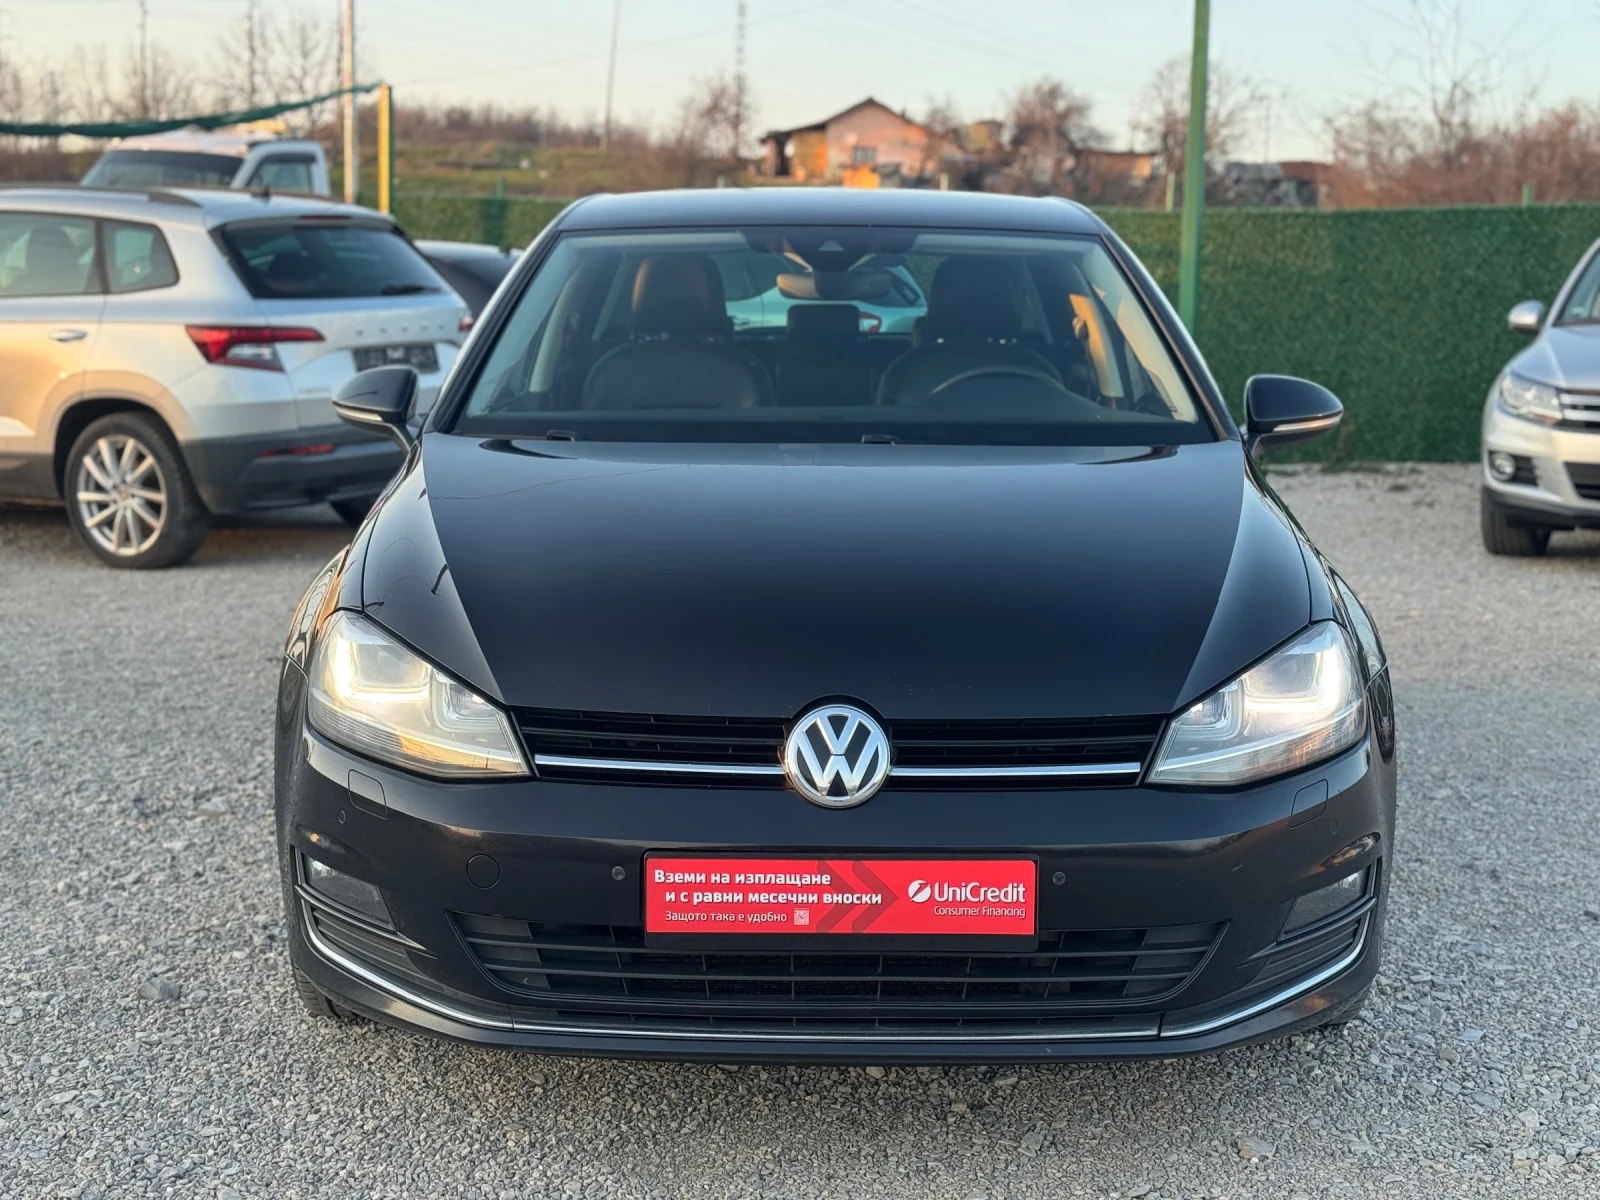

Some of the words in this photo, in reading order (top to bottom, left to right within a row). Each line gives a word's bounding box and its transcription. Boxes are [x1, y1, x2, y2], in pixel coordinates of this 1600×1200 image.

[654, 869, 706, 883] Вземи
[711, 873, 731, 884] на
[735, 873, 831, 887] изплащане
[665, 891, 676, 902] и
[680, 891, 689, 902] с
[693, 891, 744, 905] равни
[748, 892, 818, 903] месечни
[823, 893, 882, 904] вноски
[934, 881, 1026, 903] UniCredit
[665, 910, 707, 922] Защото
[710, 913, 735, 921] така
[738, 913, 745, 921] е
[747, 912, 787, 924] удобно
[934, 905, 980, 916] Consumer
[982, 906, 1026, 919] Financing
